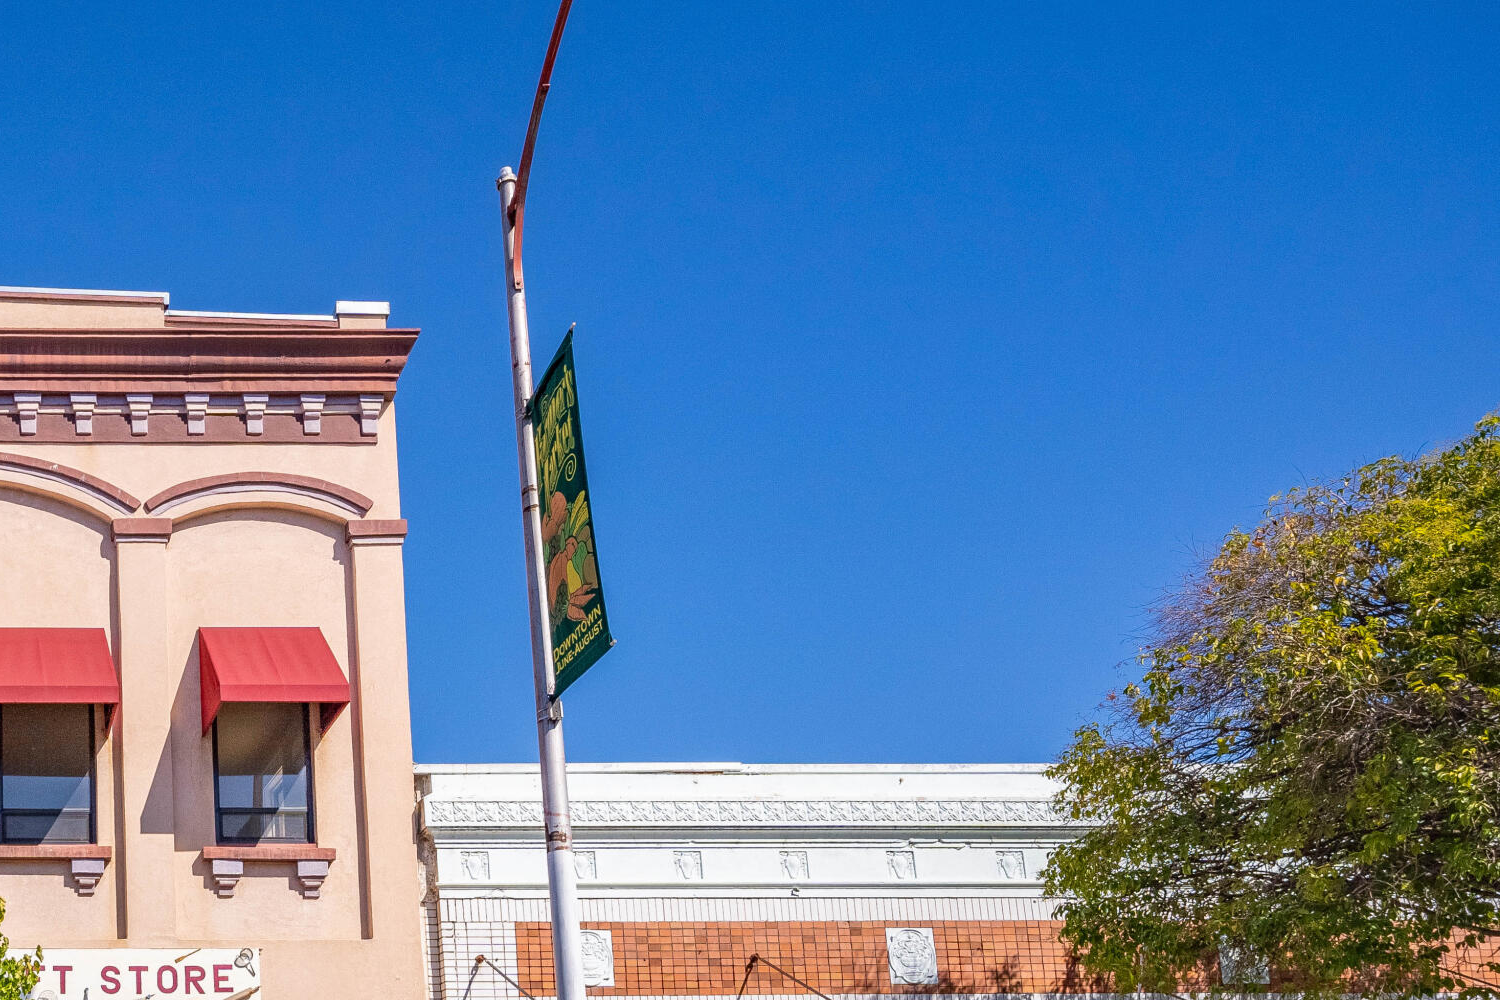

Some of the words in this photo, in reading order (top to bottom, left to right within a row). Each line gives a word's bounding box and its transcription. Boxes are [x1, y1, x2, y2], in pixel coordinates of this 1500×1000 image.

[553, 604, 601, 662] DOWNTOWN
[556, 618, 603, 675] JUNE-AUGUST
[101, 964, 234, 994] STORE
